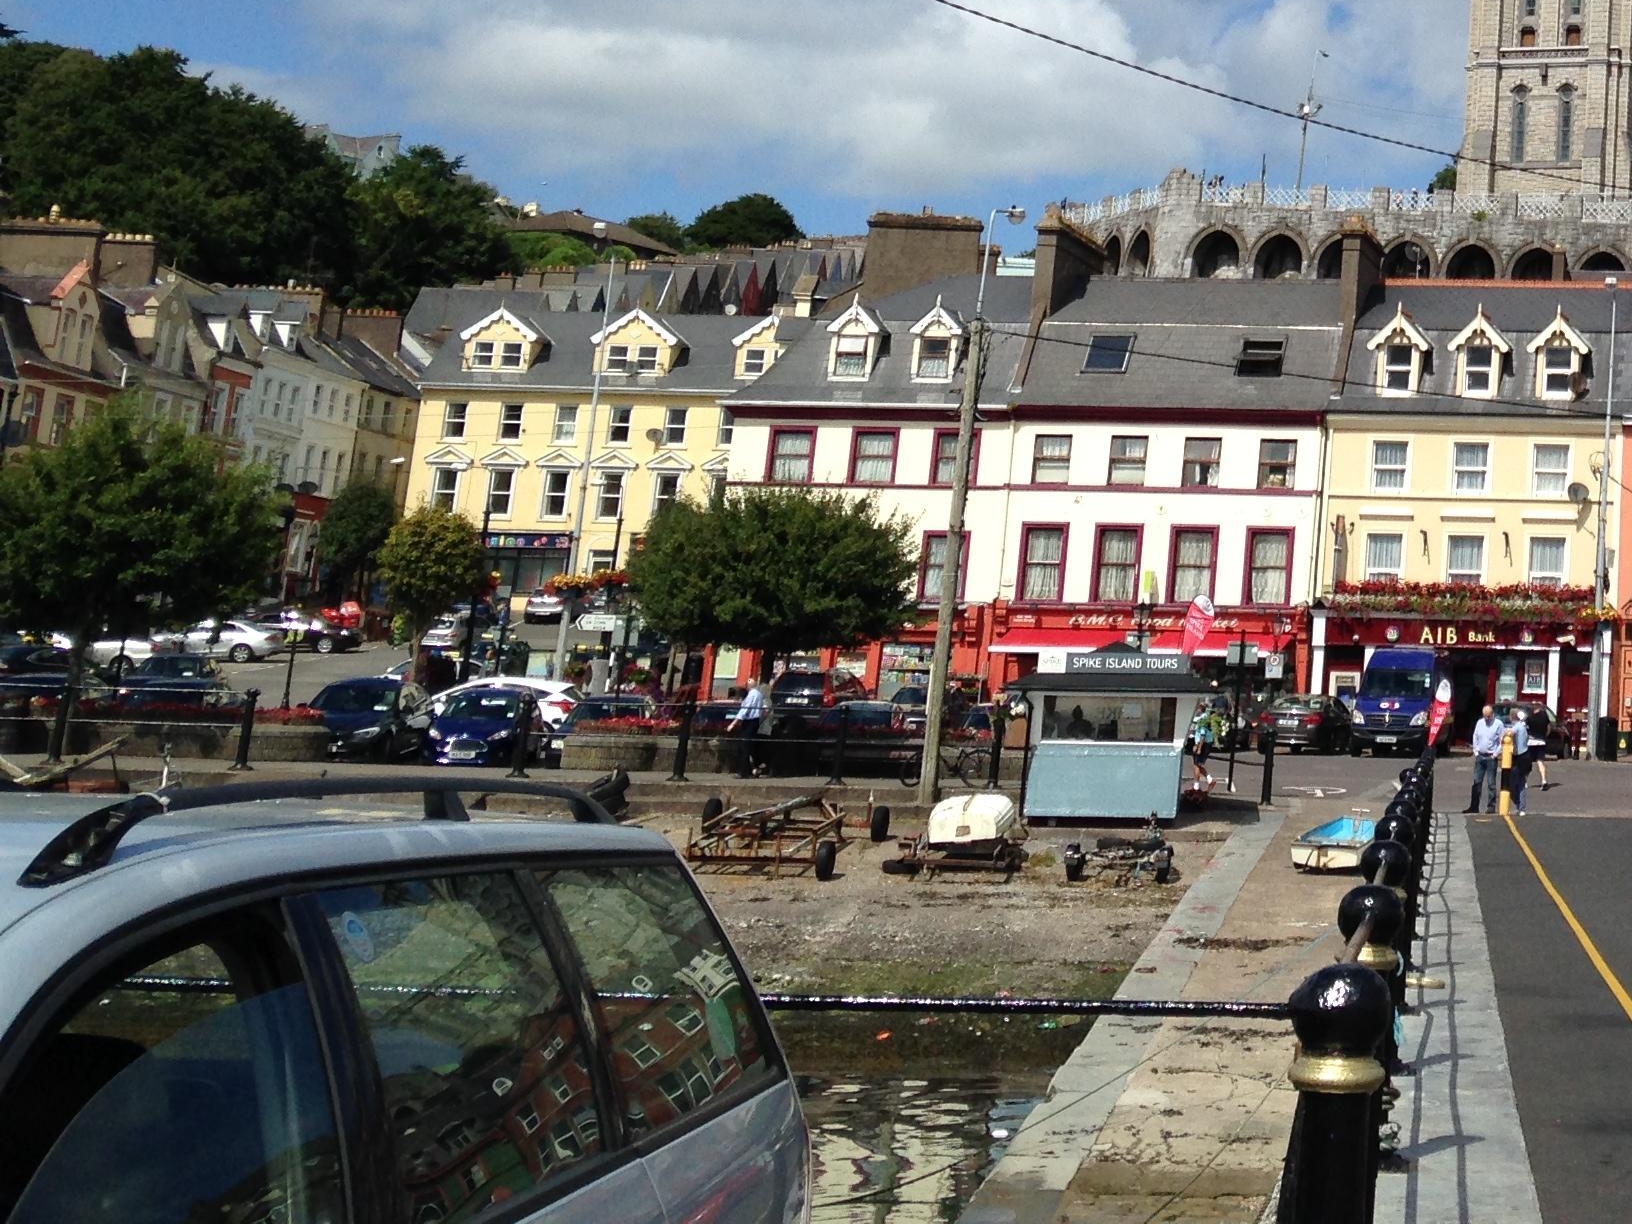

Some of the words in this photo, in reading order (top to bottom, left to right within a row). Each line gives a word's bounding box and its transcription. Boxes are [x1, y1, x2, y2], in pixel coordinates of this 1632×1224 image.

[1419, 626, 1458, 645] AIB
[1467, 631, 1496, 644] Bank
[1072, 657, 1101, 669] SPIKE
[1105, 657, 1142, 669] ISLAND
[1146, 658, 1178, 670] TOURS
